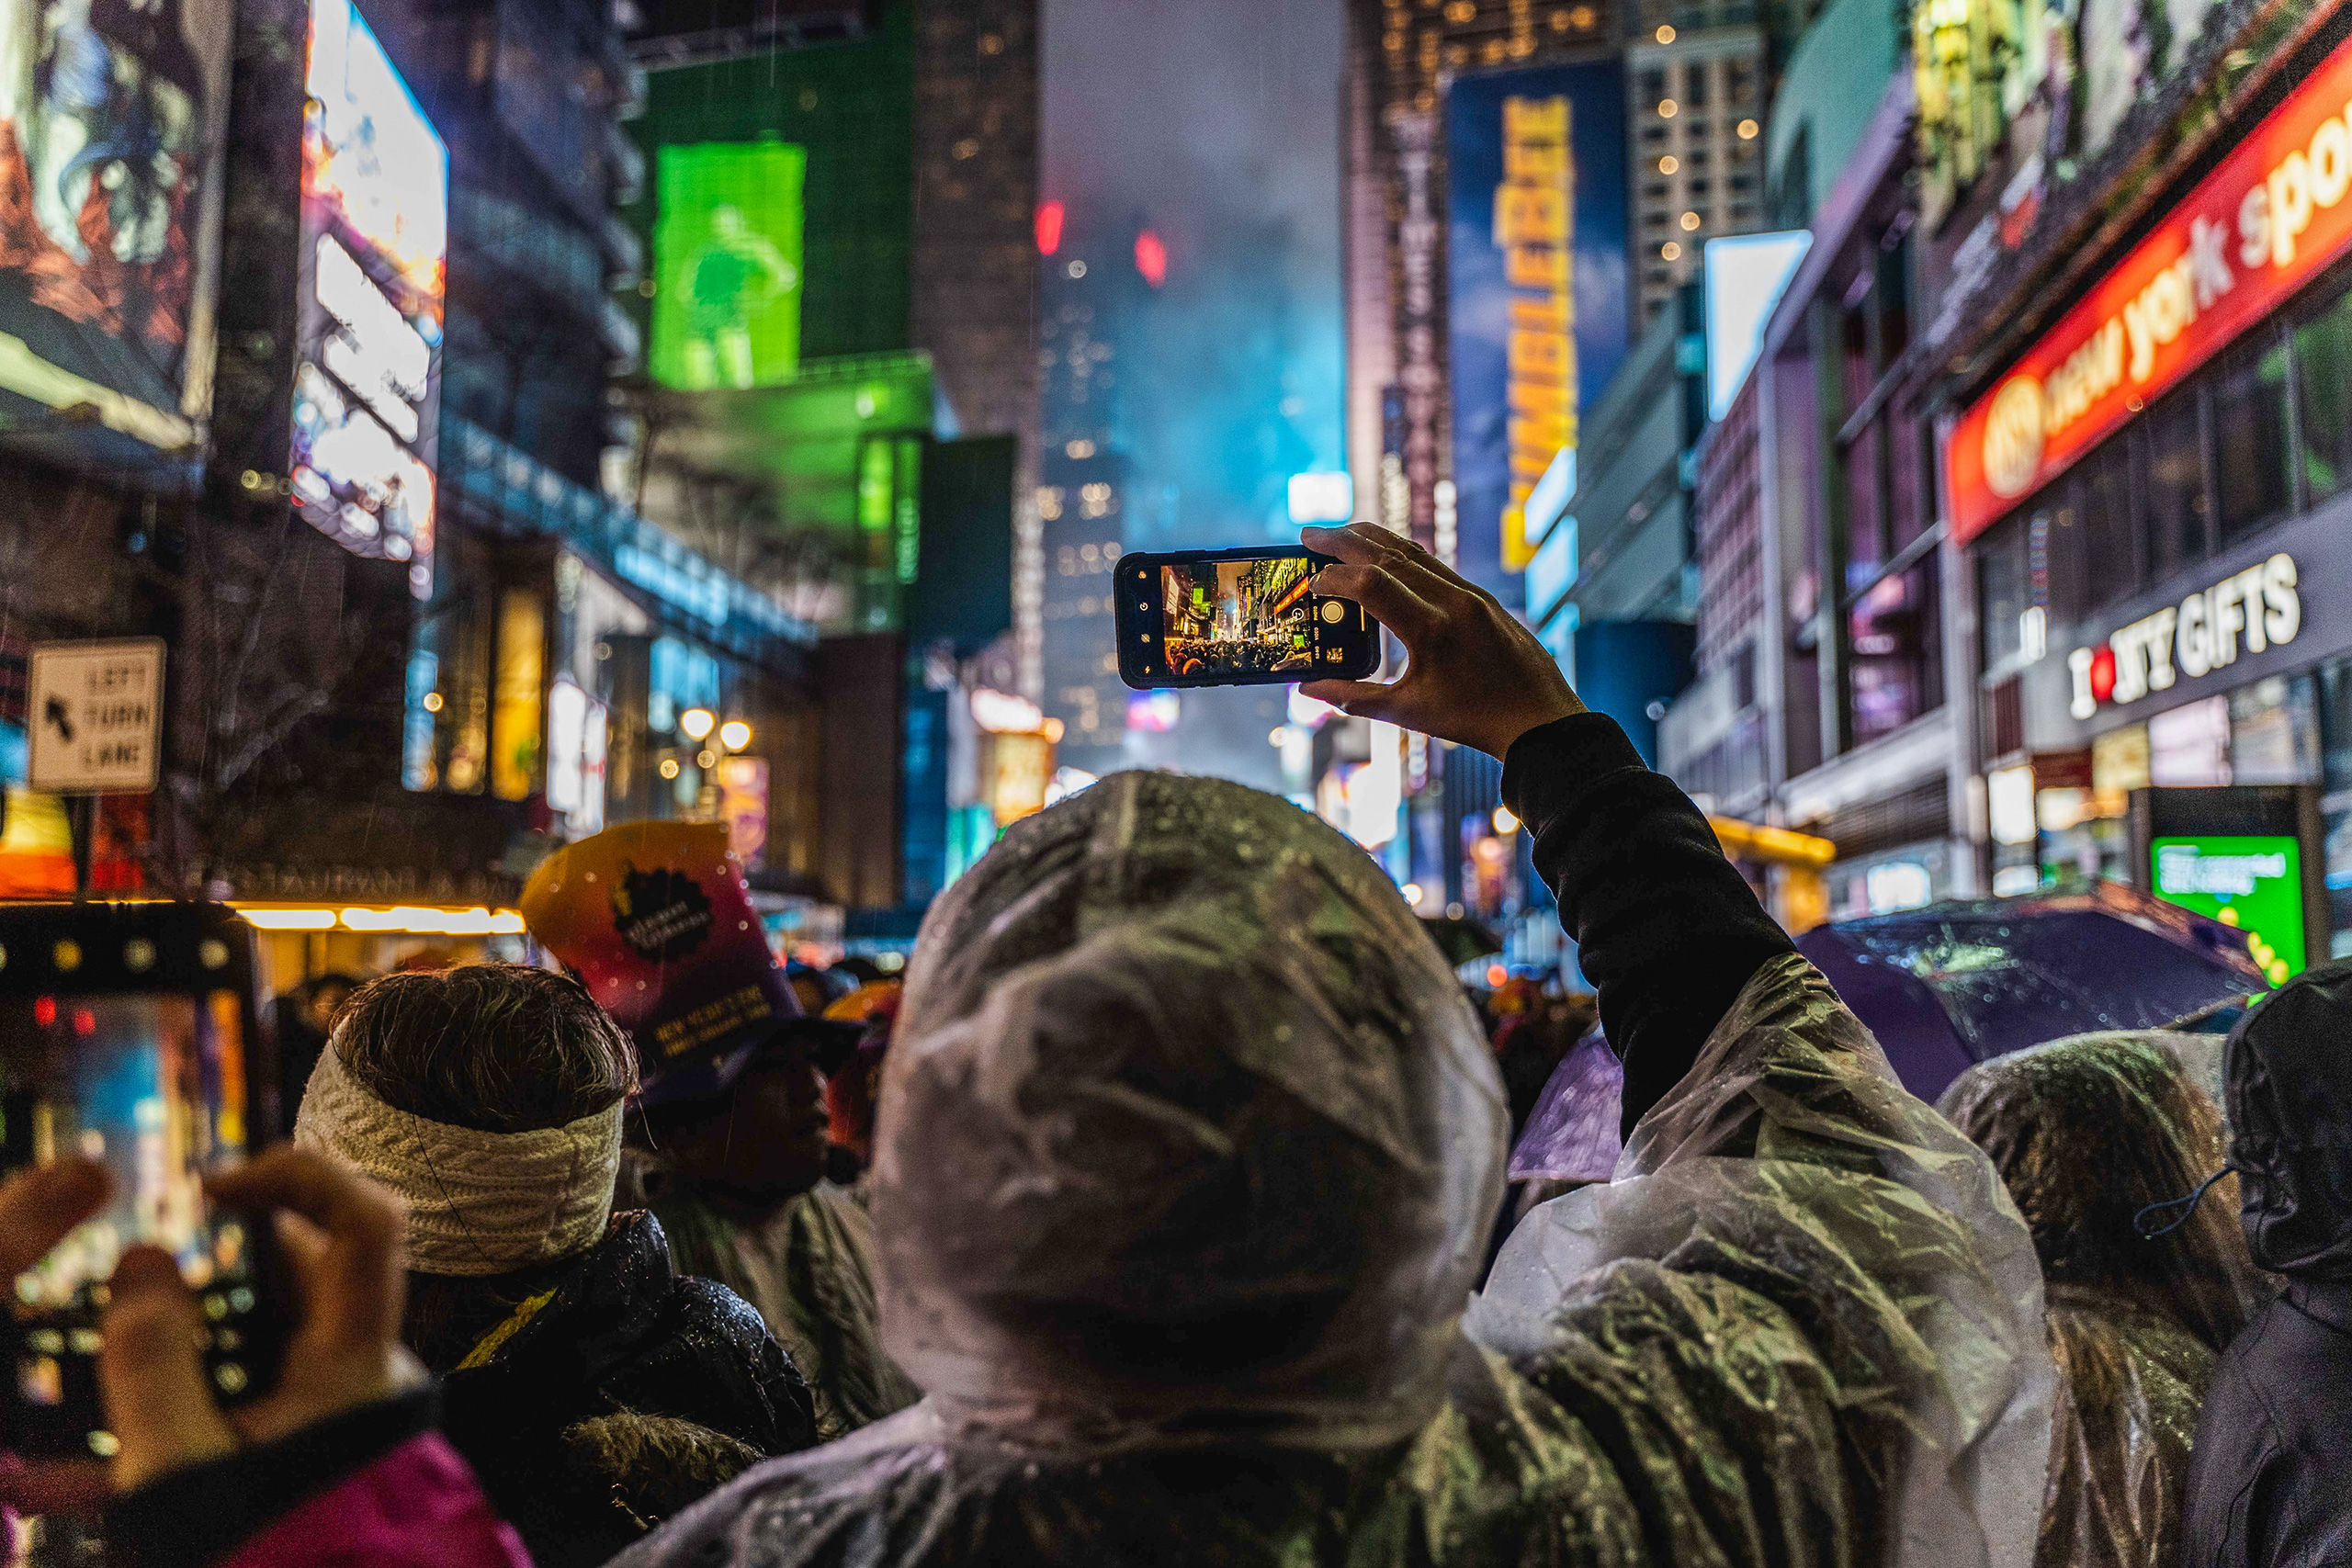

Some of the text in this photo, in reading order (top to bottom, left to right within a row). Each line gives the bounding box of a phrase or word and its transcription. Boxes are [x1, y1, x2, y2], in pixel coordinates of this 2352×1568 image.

[2123, 213, 2234, 385] york
[2109, 606, 2178, 705] NY
[2176, 553, 2301, 678] GIFTS
[87, 659, 147, 694] LEFT
[85, 698, 152, 731] TURN
[80, 742, 141, 772] LANE
